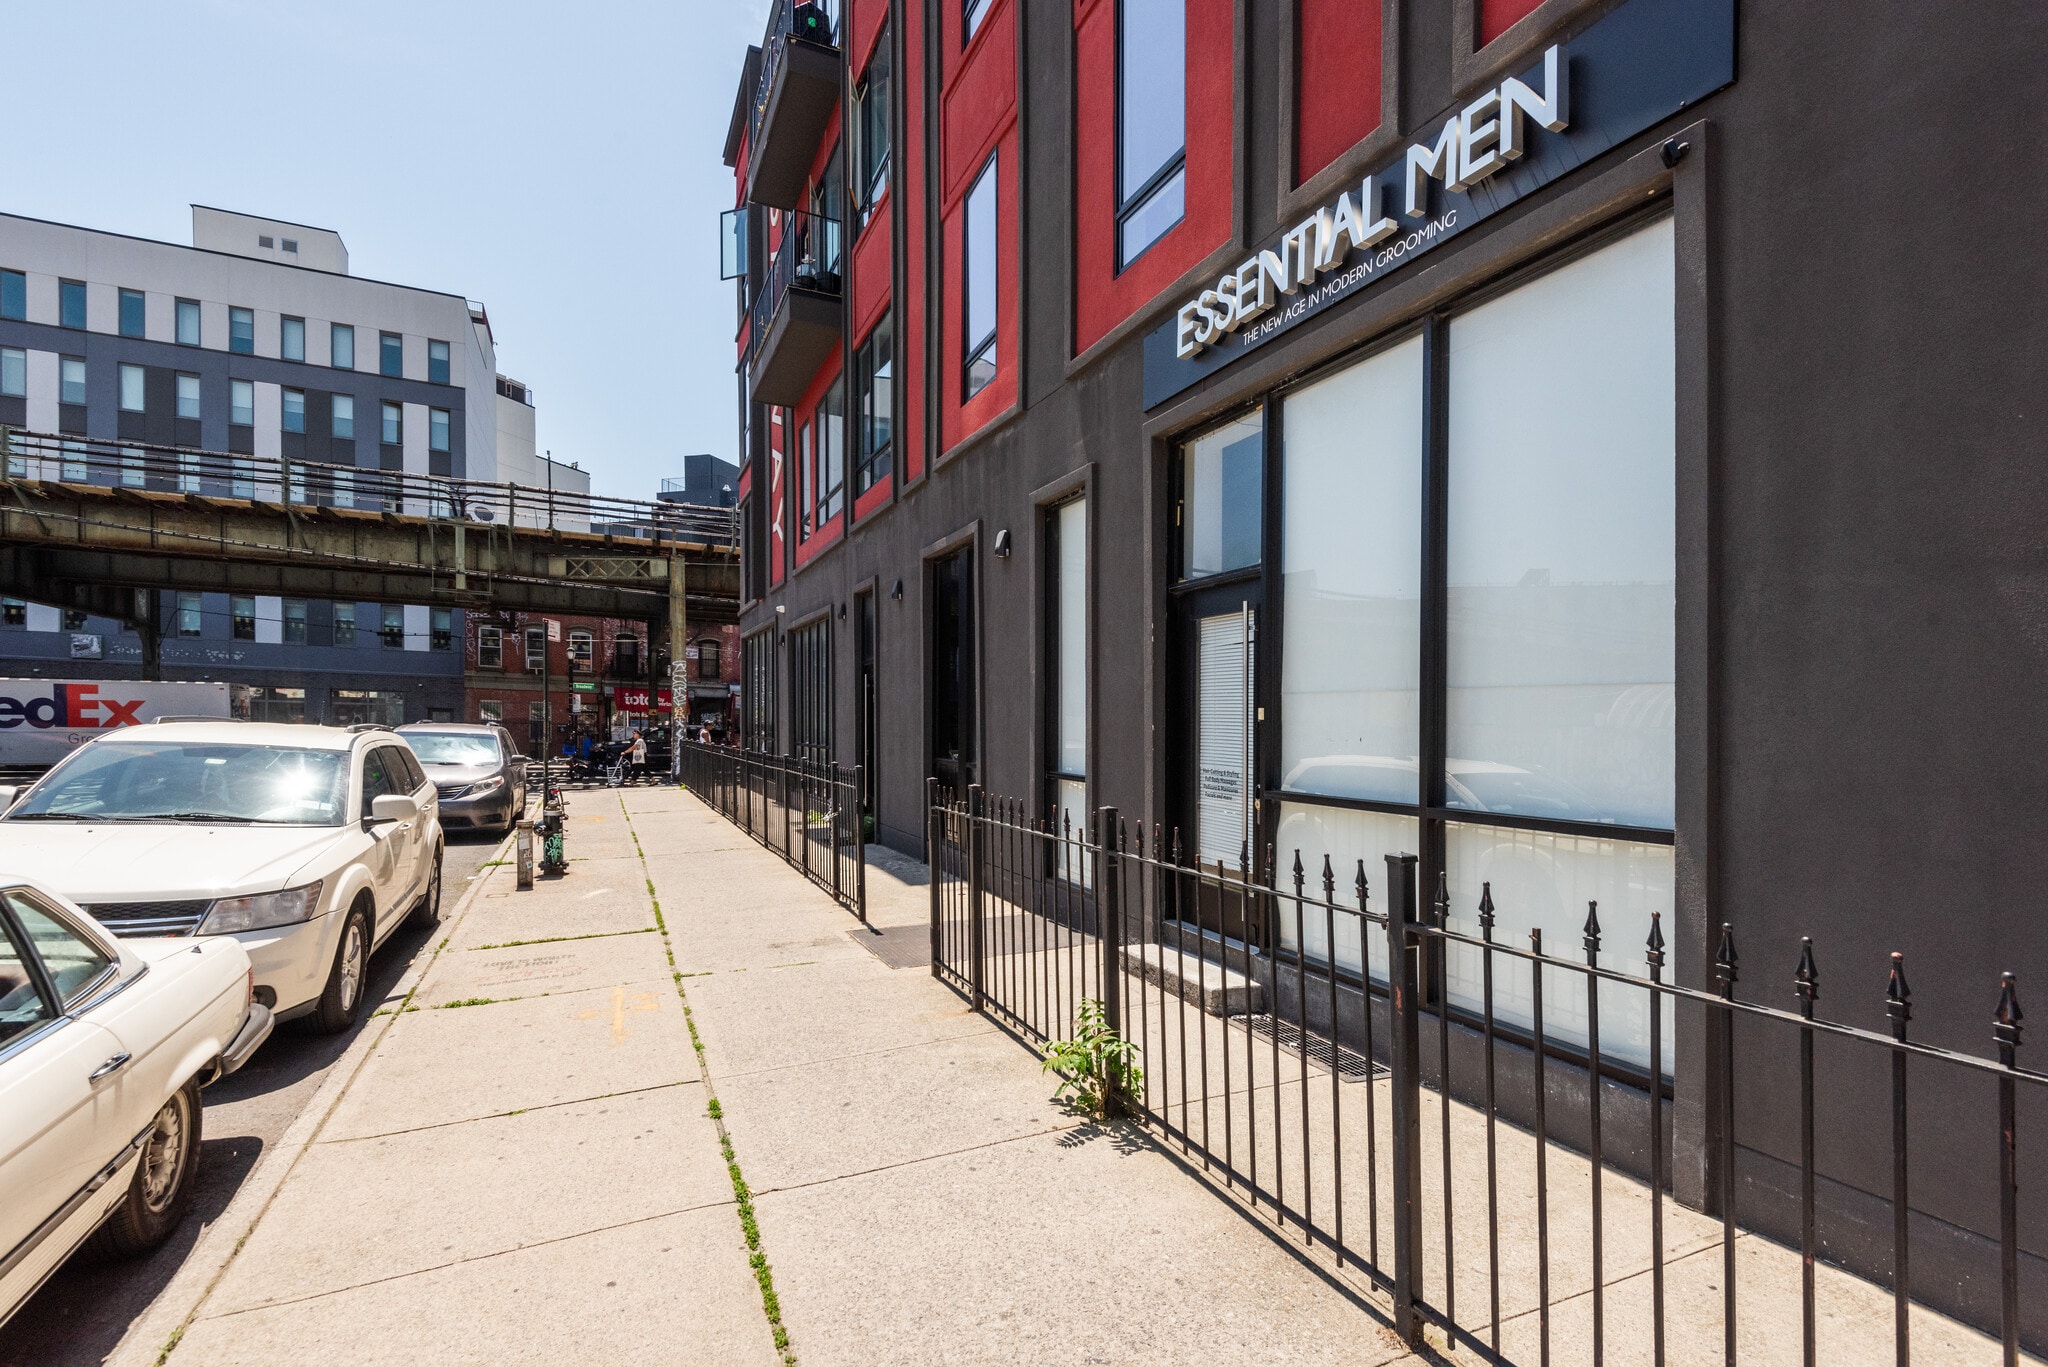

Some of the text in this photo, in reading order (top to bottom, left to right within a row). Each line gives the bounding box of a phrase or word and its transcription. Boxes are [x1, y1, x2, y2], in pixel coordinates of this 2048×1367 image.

[1177, 44, 1569, 359] ESSENTIAL MEN
[1243, 210, 1457, 346] THE NEW AGE IN MODERN GROOMING
[0, 683, 146, 729] edEx
